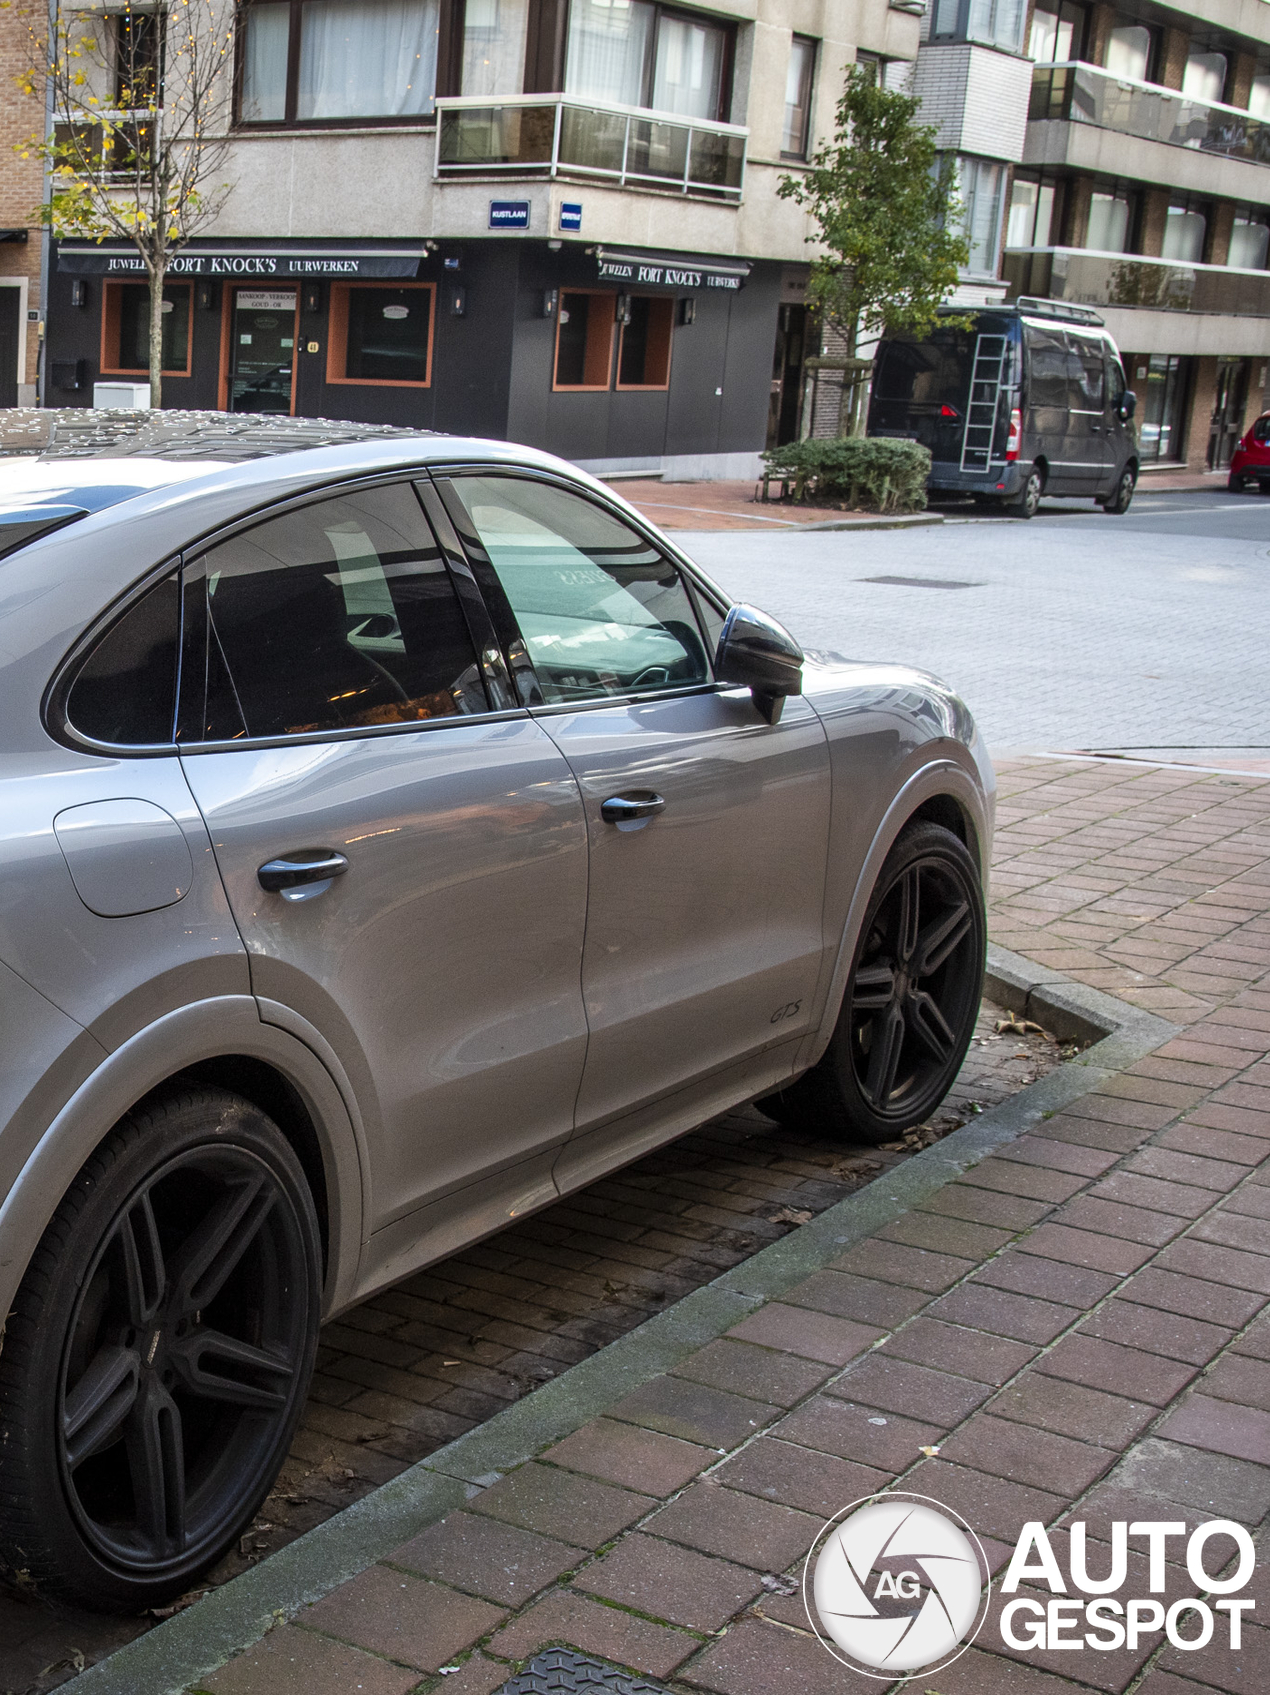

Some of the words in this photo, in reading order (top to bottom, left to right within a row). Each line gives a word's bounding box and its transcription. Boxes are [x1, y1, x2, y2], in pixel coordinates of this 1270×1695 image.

[211, 257, 276, 273] KNOCK'S
[289, 260, 359, 271] UURWERKEN
[638, 266, 663, 283] FORT
[665, 269, 701, 287] KNOCK'S
[771, 999, 802, 1023] GTS
